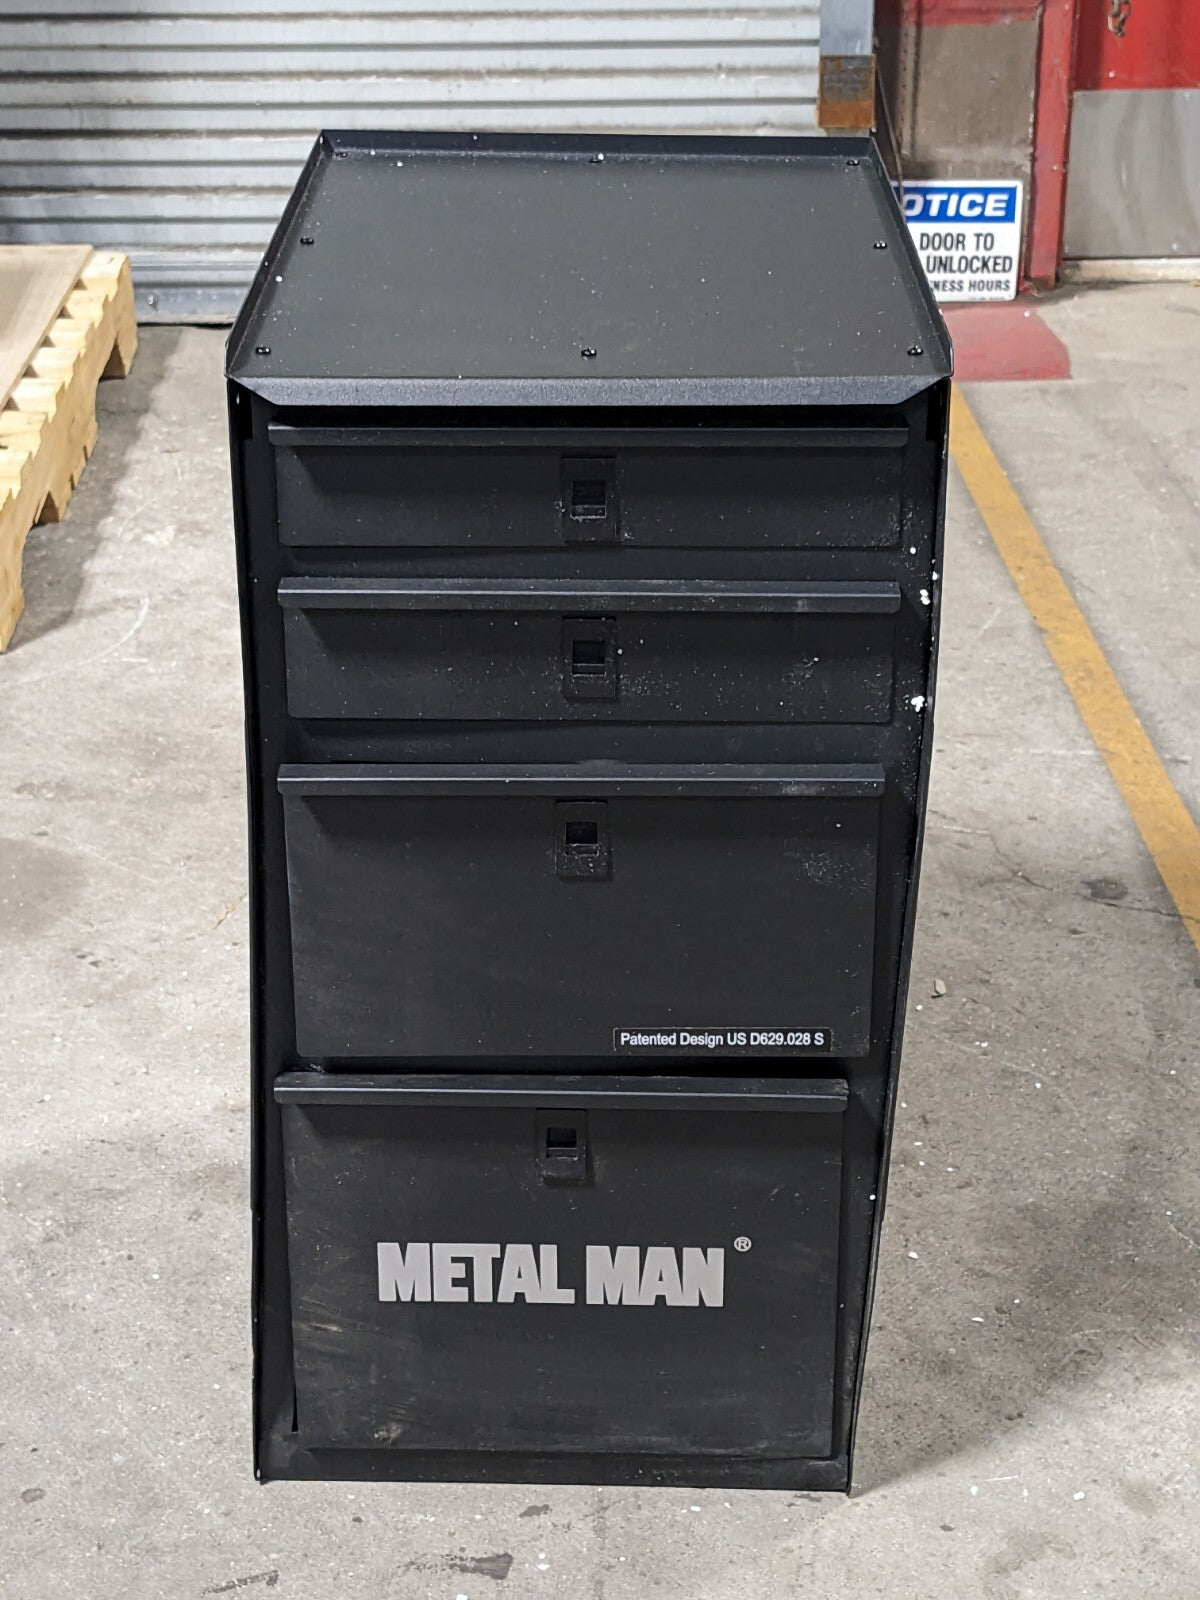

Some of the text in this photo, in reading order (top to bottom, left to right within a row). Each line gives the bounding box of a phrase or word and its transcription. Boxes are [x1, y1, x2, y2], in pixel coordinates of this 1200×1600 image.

[902, 193, 1009, 217] OTICE
[920, 233, 995, 251] DOOR TO
[926, 255, 1013, 274] UNLOCKED
[968, 280, 1011, 292] HOURS
[620, 1032, 825, 1048] Patented Design US D629.028 S
[377, 1242, 575, 1304] METAL
[586, 1245, 725, 1307] MAN
